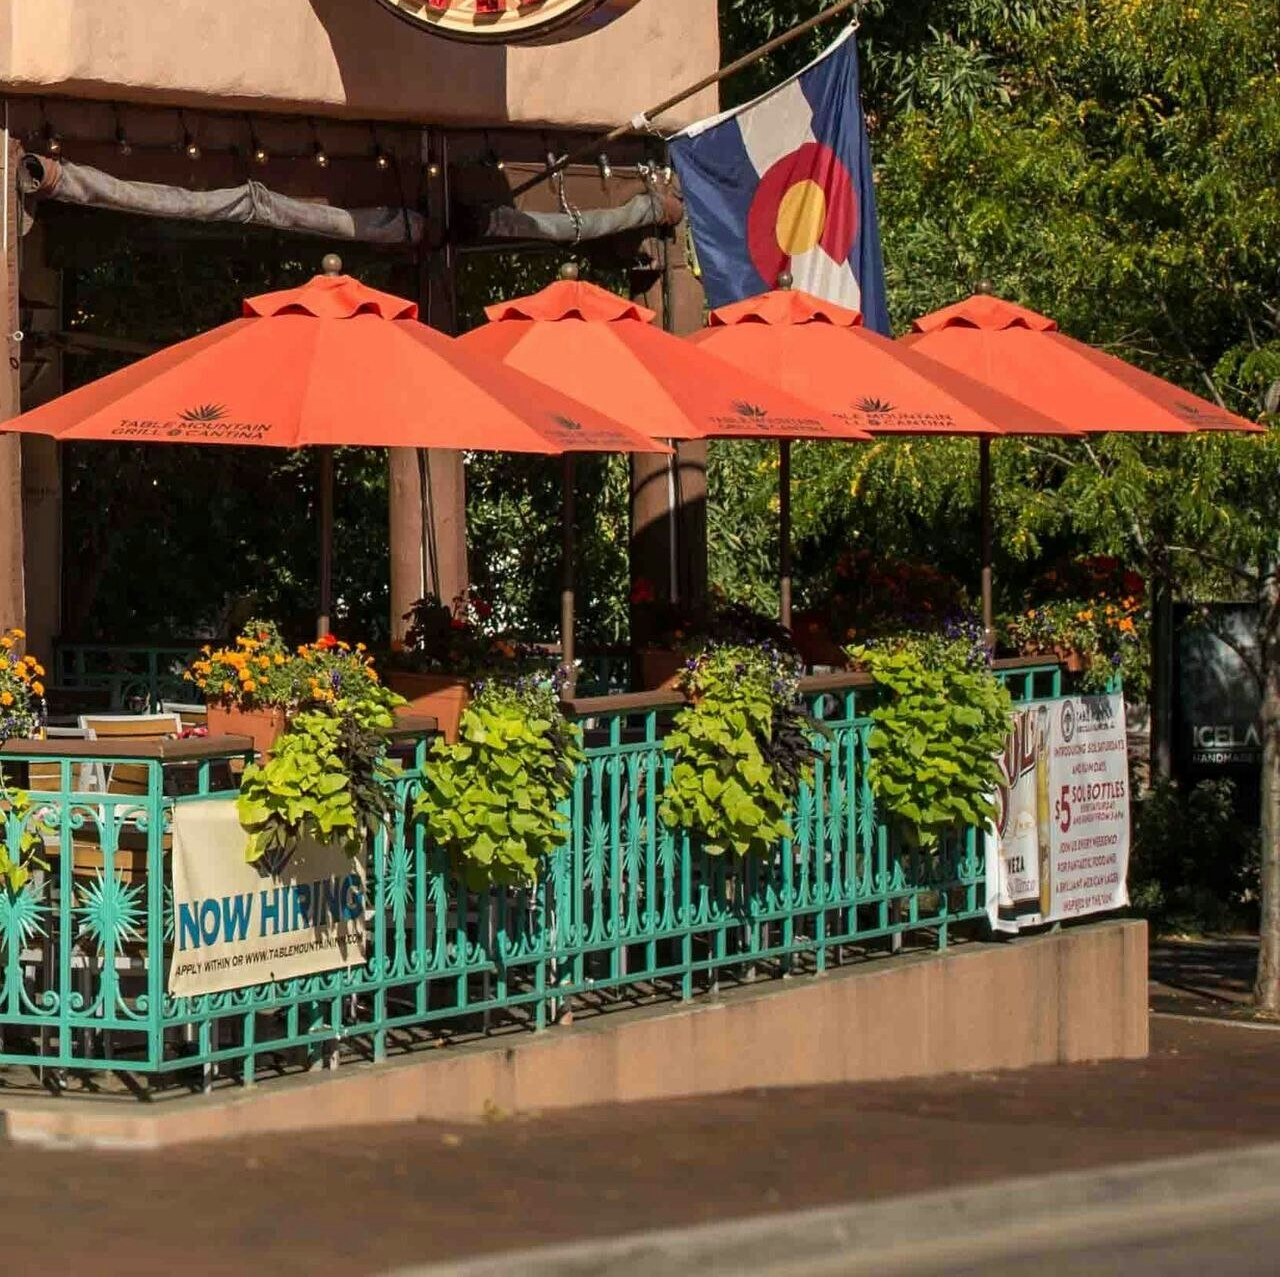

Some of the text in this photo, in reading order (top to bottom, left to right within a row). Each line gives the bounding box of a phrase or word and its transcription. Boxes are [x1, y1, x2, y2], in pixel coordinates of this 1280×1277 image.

[1087, 781, 1124, 800] BOTTLES
[178, 874, 364, 951] NOW HIRING
[175, 964, 203, 977] APPLY
[204, 958, 231, 972] WITHIN
[232, 954, 245, 967] OR
